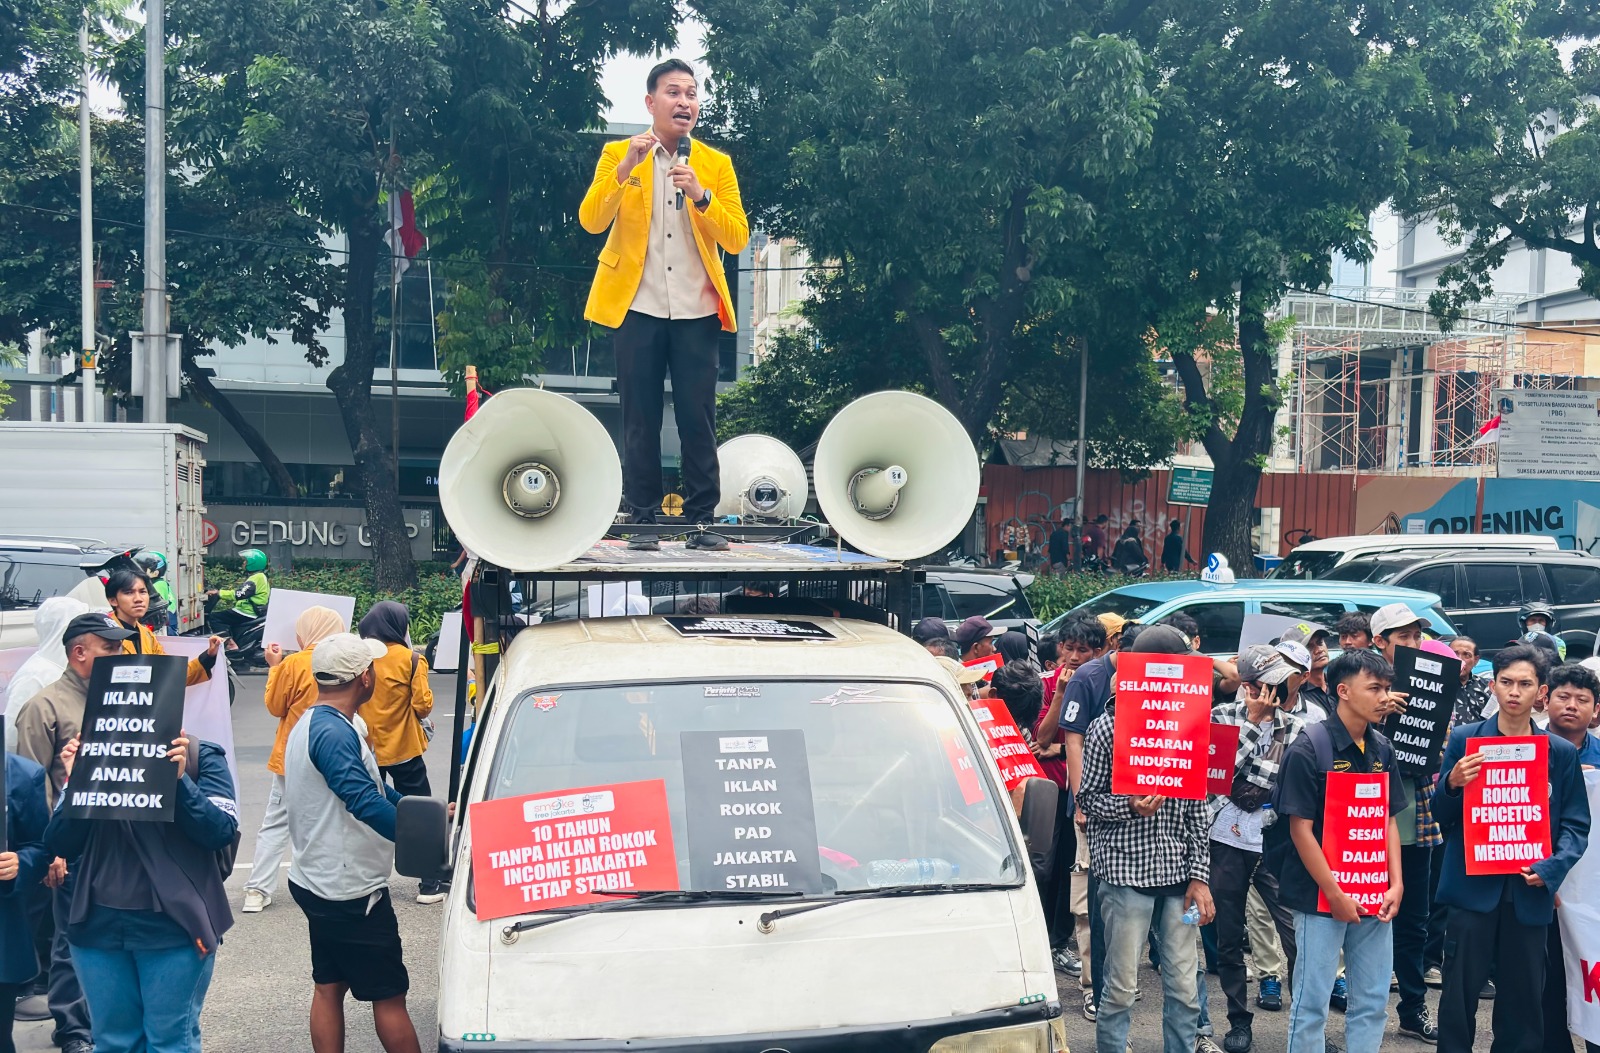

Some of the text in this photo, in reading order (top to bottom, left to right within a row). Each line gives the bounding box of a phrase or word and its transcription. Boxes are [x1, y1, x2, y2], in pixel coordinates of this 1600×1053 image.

[1428, 505, 1564, 534] OPENING
[231, 520, 348, 546] GEDUNG
[1119, 680, 1209, 695] SELAMATKAN
[1409, 676, 1444, 694] TOLAK
[103, 692, 154, 706] IKLAN
[1408, 696, 1437, 712] ASAP
[1065, 700, 1080, 722] 8
[95, 718, 156, 733] ROKOK
[1146, 719, 1179, 731] DARI
[1399, 713, 1435, 732] ROKOK
[990, 725, 1017, 739] ROKOK
[1393, 730, 1430, 749] DALAM
[81, 742, 167, 758] PENCETUS
[992, 743, 1030, 759] RGETKAN
[1130, 737, 1193, 751] SASARAN
[715, 758, 777, 770] TANPA
[1129, 755, 1192, 770] INDUSTRI
[1395, 750, 1428, 766] EDUNG
[91, 767, 145, 782] ANAK
[1002, 763, 1038, 782] K-ANAK
[1486, 768, 1526, 785] IKLAN
[724, 780, 777, 793] IKLAN
[1137, 774, 1183, 788] ROKOK
[72, 792, 163, 808] MEROKOK
[1483, 787, 1530, 804] ROKOK
[534, 798, 575, 812] smoke
[550, 808, 575, 818] jakarta
[720, 802, 782, 816] ROKOK
[1347, 806, 1384, 818] NAPAS
[1471, 805, 1542, 824] PENCETUS
[531, 817, 611, 843] 10 TAHUN
[734, 826, 772, 840] PAD
[1348, 828, 1384, 840] SESAK
[1489, 824, 1527, 842] ANAK
[489, 830, 657, 869] TANPA IKLAN ROKOK
[713, 849, 797, 866] JAKARTA
[1342, 851, 1386, 863] DALAM
[1474, 843, 1544, 861] MEROKOK
[503, 850, 648, 886] INCOME JAKARTA
[520, 870, 634, 903] TETAP STABIL
[726, 873, 789, 889] STABIL
